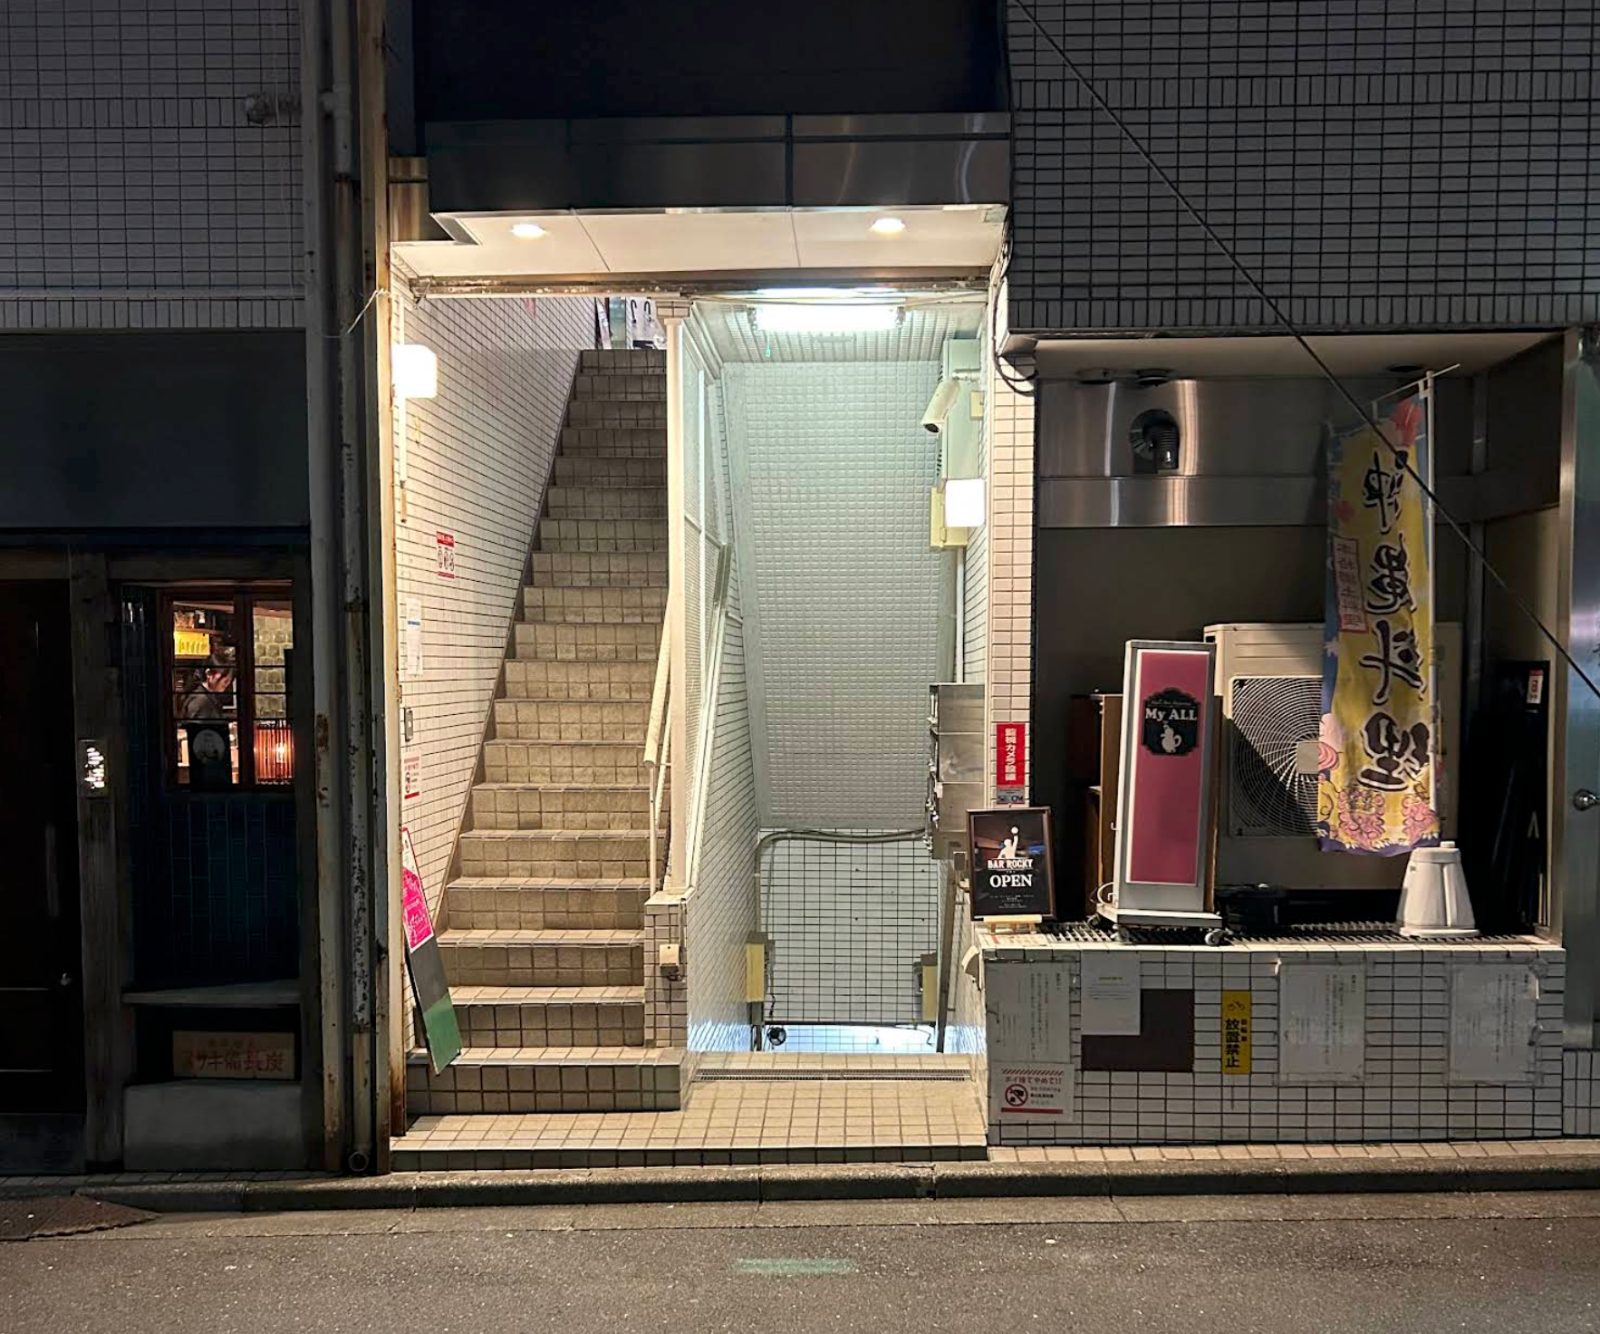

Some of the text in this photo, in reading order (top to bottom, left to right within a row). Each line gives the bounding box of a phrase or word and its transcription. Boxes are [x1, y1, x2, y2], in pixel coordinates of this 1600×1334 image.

[1145, 707, 1197, 722] My ALL
[987, 859, 1034, 870] BAR ROCKY
[989, 874, 1033, 888] OPEN
[1225, 1018, 1240, 1068] 放置禁止
